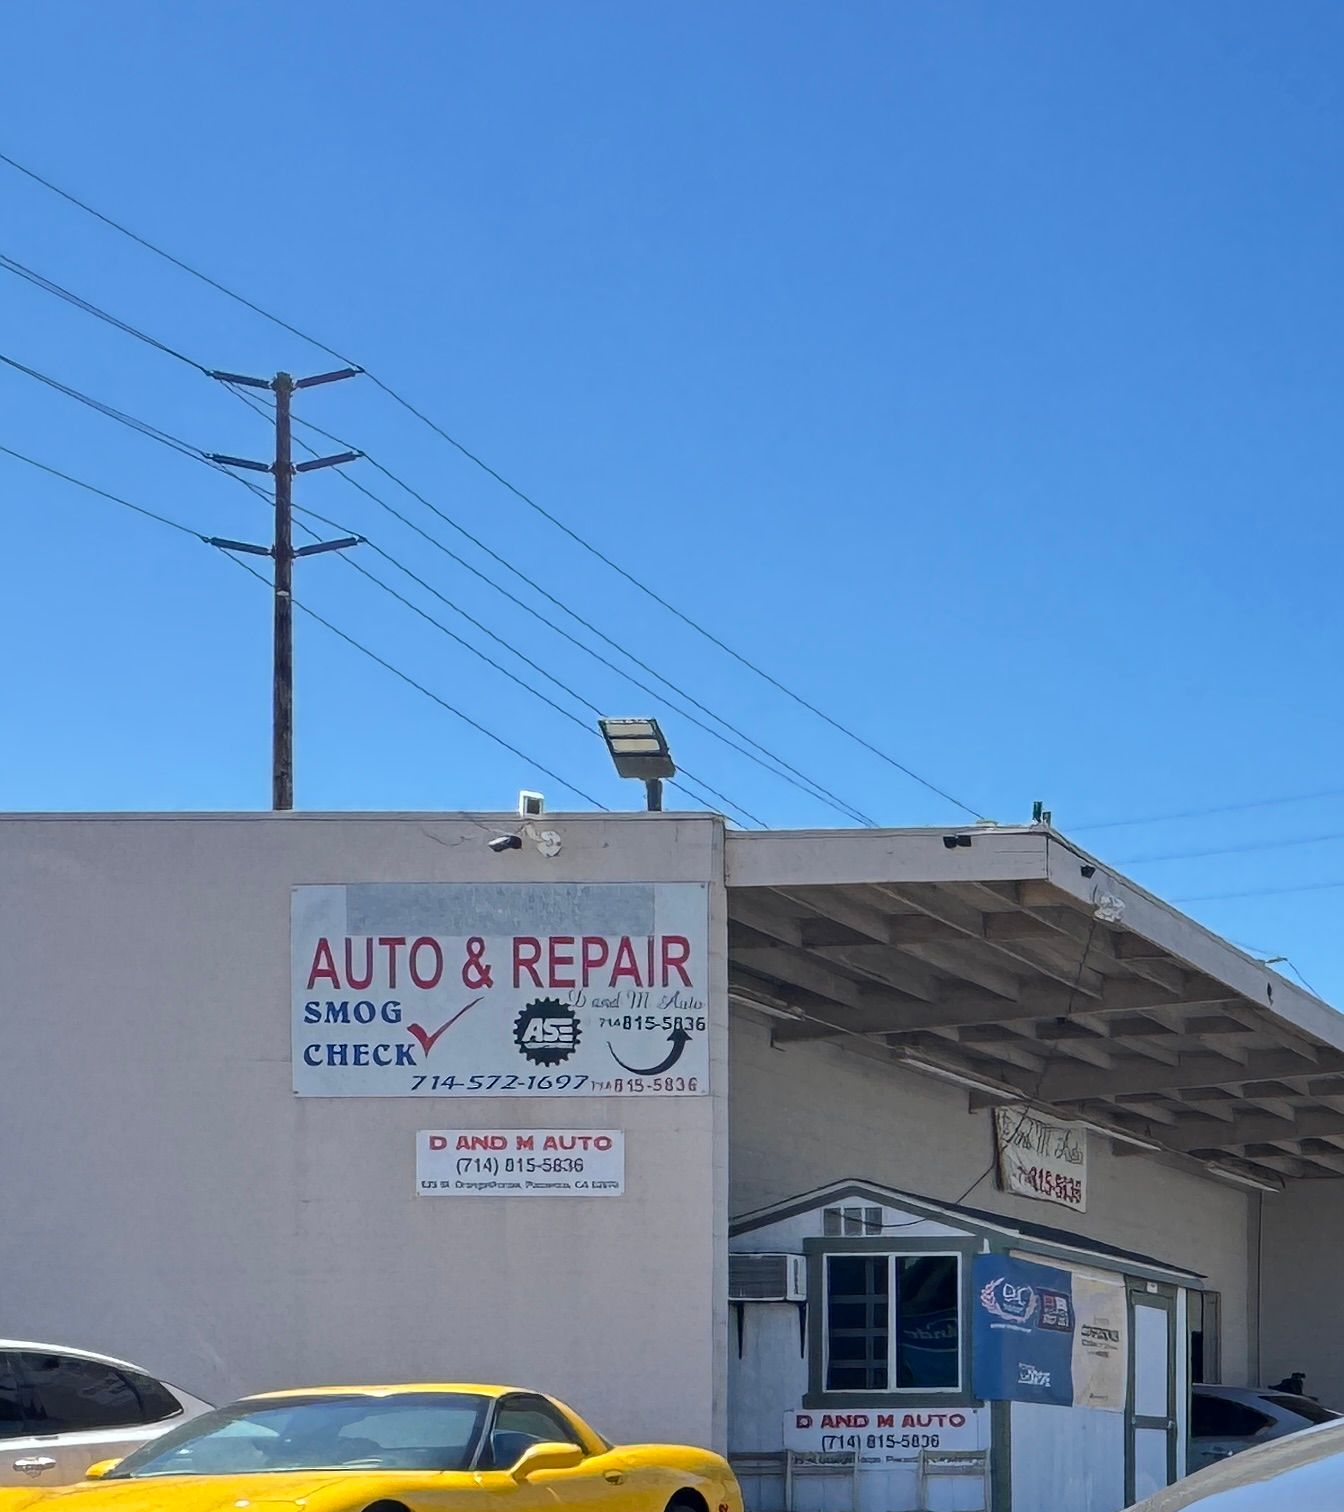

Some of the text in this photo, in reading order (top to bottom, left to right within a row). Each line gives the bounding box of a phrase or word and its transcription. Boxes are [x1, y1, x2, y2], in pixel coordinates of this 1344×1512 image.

[306, 935, 693, 990] AUTO & REPAIR
[591, 991, 620, 1010] and
[626, 990, 649, 1010] M
[657, 989, 706, 1010] Auto
[304, 1000, 402, 1024] SMOG
[521, 1017, 574, 1043] ASE
[303, 1043, 417, 1067] CHECK
[411, 1074, 590, 1091] 714-572-1697
[429, 1135, 613, 1151] D AND M AUTO
[456, 1157, 584, 1176] (714) 815-5836
[796, 1413, 966, 1429] D AND M AUTO
[822, 1434, 940, 1452] (714) 815-5836
